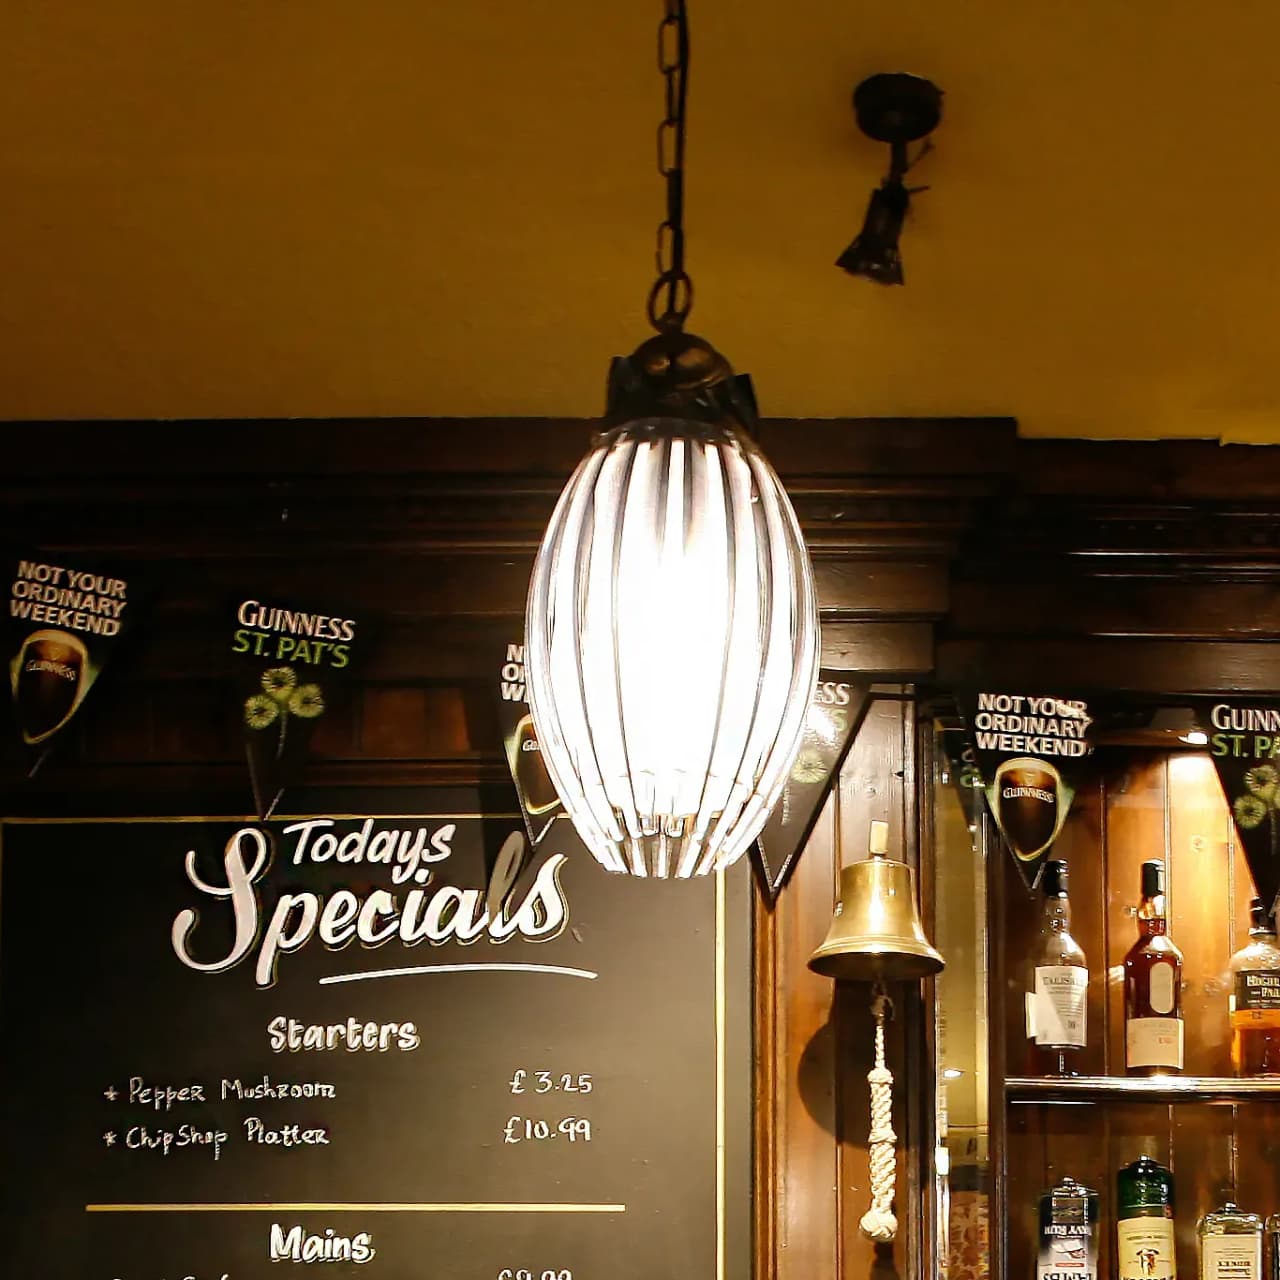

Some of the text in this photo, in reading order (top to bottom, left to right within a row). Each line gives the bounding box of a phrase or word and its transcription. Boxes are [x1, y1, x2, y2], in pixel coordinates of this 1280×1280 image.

[18, 560, 127, 599] NOT YOUR
[11, 580, 128, 618] ORDINARY
[10, 600, 122, 636] WEEKEND
[237, 600, 356, 641] GUINNESS
[232, 629, 350, 669] ST. PAT'S
[977, 692, 1025, 712] NOT
[974, 712, 1091, 738] ORDINARY
[975, 731, 1088, 757] WEEKEND
[1211, 733, 1249, 758] ST.
[172, 826, 572, 990] Specials
[267, 1015, 421, 1052] Starters
[503, 1117, 592, 1143] £10.99
[270, 1222, 376, 1264] Mains
